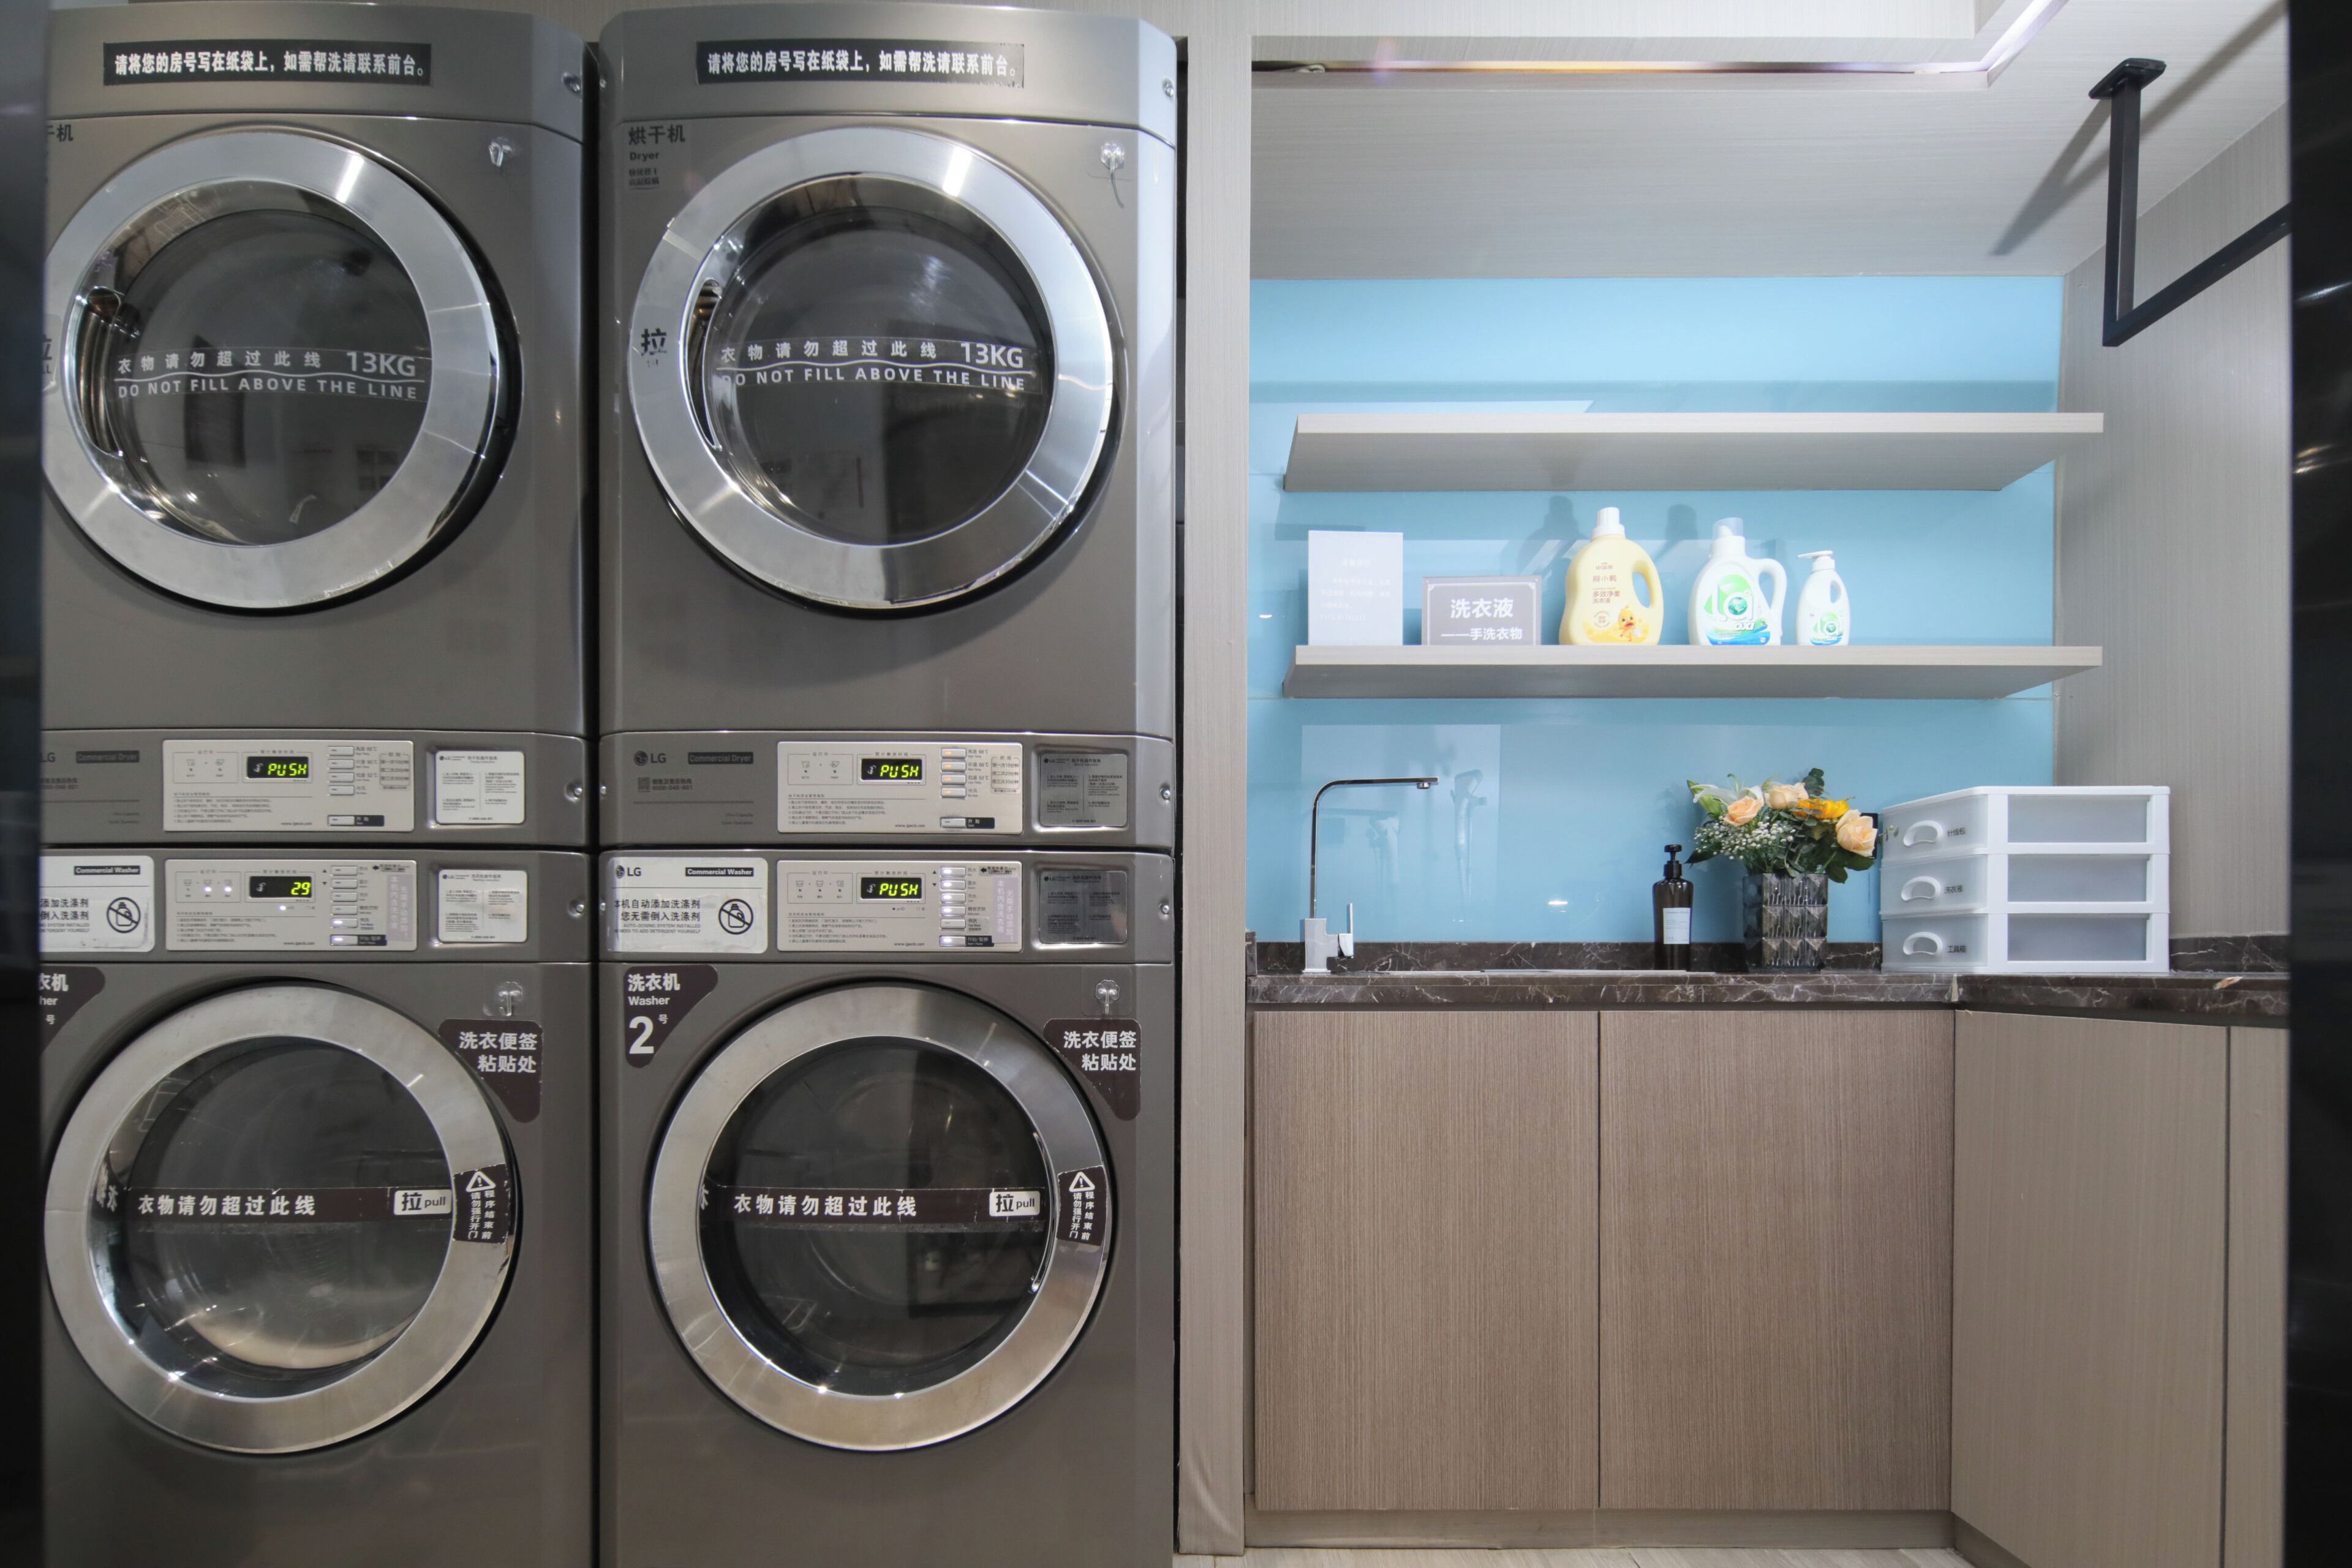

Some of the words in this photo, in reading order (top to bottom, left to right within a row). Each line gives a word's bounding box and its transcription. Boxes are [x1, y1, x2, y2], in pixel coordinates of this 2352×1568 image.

[628, 124, 685, 145] 烘干机
[630, 152, 660, 162] Dryer
[641, 328, 667, 356] 拉
[720, 339, 937, 363] 衣物请勿超过此线
[961, 342, 1025, 368] 13KG
[118, 350, 321, 374] 衣物请勿超过此线
[346, 351, 416, 377] 13KG
[118, 384, 139, 398] DO
[148, 380, 181, 396] NOT
[191, 378, 229, 391] FILL
[239, 377, 307, 392] ABOVE
[318, 380, 356, 395] THE
[368, 383, 417, 400] LINE
[756, 369, 794, 385] NOT
[804, 368, 845, 382] FILL
[855, 368, 924, 383] ABOVE
[933, 370, 971, 385] THE
[981, 374, 1026, 391] LINE
[1450, 597, 1514, 619] 洗衣液
[650, 753, 666, 763] LG
[731, 754, 752, 763] Dryer
[267, 763, 307, 777] PUSH
[880, 764, 919, 778] PUSH
[1947, 827, 1966, 837] 针线包
[627, 867, 641, 876] LG
[290, 882, 311, 895] 29
[879, 883, 918, 896] PUSH
[1944, 885, 1964, 894] 洗衣液
[614, 899, 701, 909] 本机自动添加洗涤剂
[621, 911, 701, 922] 您无需倒入洗涤剂
[1947, 945, 1966, 954] 工具箱
[628, 973, 680, 992] 洗衣机
[39, 996, 58, 1005] her
[628, 996, 670, 1006] Washer
[45, 1014, 56, 1025] 号
[459, 1031, 538, 1051] 洗衣便签
[1063, 1030, 1137, 1049] 洗衣便签
[477, 1054, 537, 1074] 粘贴处
[1080, 1053, 1137, 1072] 粘贴处
[138, 1194, 316, 1217] 衣物请勿超过此线
[401, 1192, 423, 1212] 拉
[424, 1196, 447, 1208] pull
[734, 1193, 918, 1218] 衣物请勿超过此线
[995, 1194, 1014, 1213] 拉
[1016, 1197, 1035, 1210] pull
[467, 1191, 482, 1240] 请勿强行开门
[481, 1189, 496, 1240] 程序结束前
[1069, 1192, 1083, 1239] 请勿强行开门
[1080, 1191, 1095, 1241] 程序结束前
